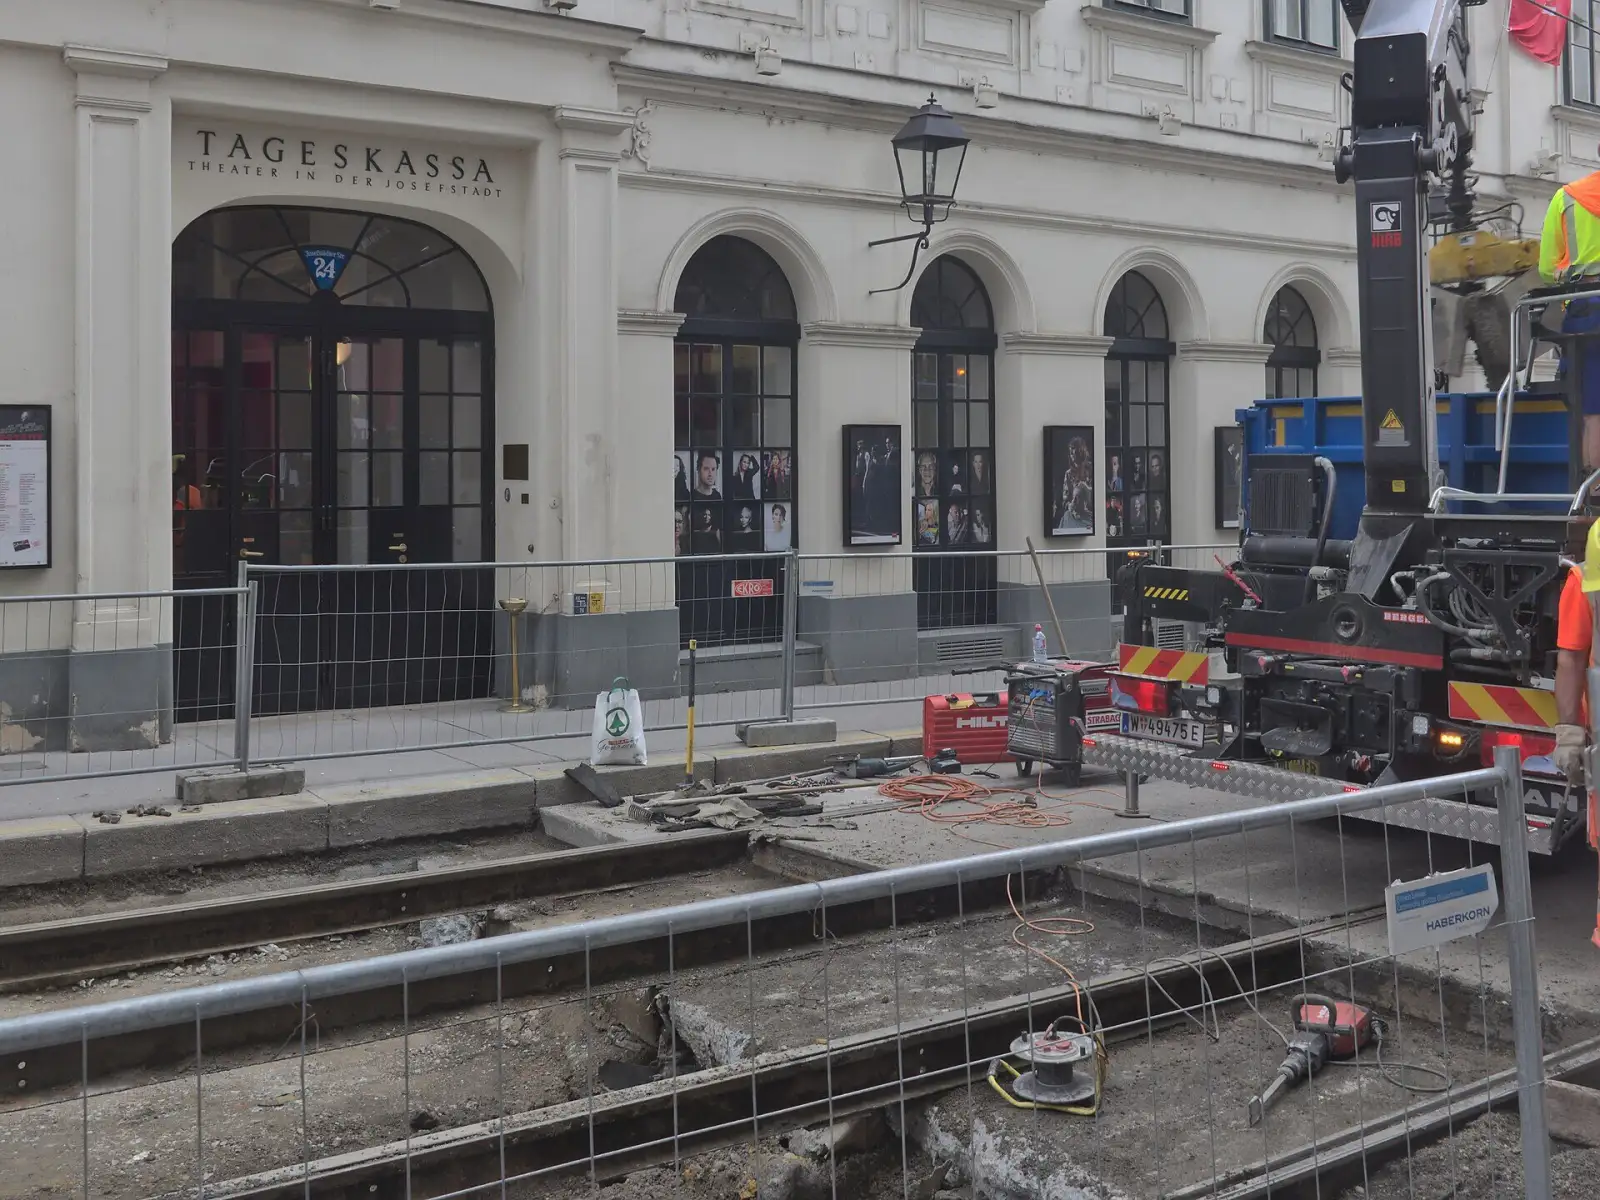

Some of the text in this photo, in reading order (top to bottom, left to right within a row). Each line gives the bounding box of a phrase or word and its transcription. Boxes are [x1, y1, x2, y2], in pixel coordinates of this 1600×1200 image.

[197, 130, 494, 183] TAGESKASSA
[188, 160, 502, 198] THEATER IN DER JOSEFSTADT
[1372, 232, 1402, 248] HIAB
[314, 257, 336, 278] 24
[956, 715, 1009, 729] HILT
[1148, 721, 1188, 740] 49475
[1191, 725, 1199, 742] E
[1523, 788, 1578, 812] AN
[1426, 906, 1490, 932] HABERKORN
